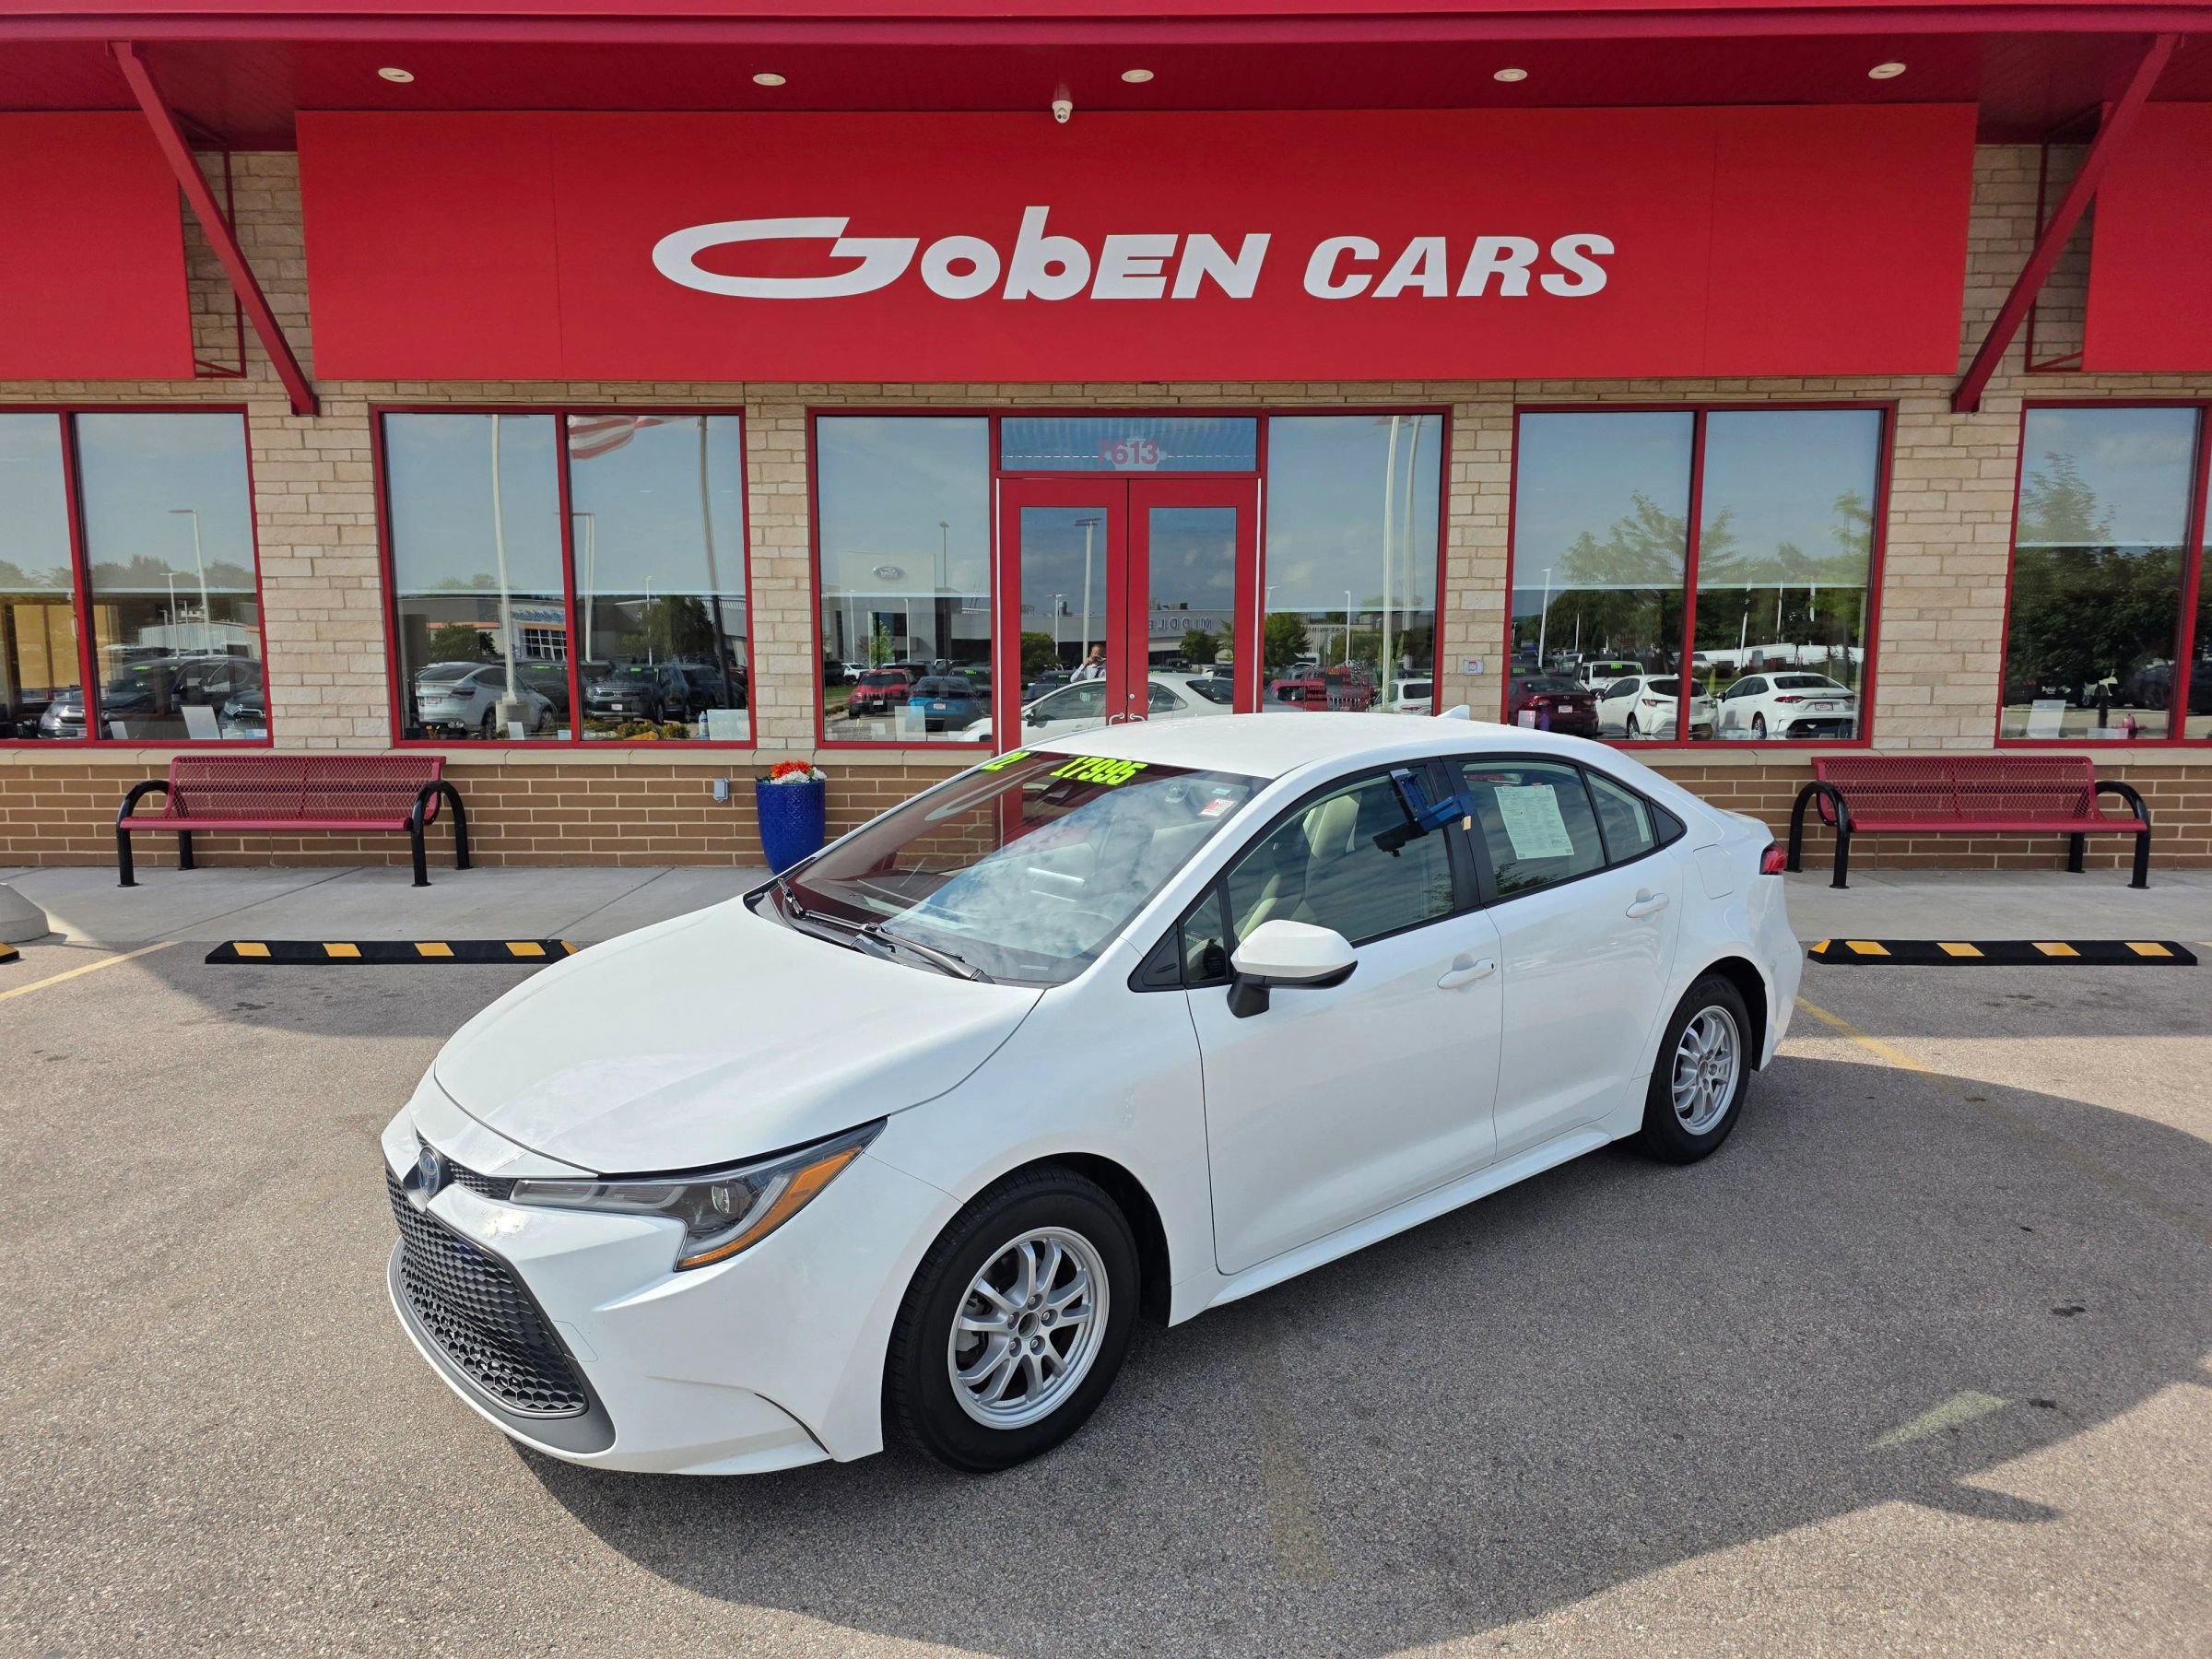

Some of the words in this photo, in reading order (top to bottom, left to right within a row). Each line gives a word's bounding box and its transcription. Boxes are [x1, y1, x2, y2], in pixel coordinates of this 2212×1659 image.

[1303, 233, 1615, 300] CARS
[1095, 439, 1159, 465] 7613
[1050, 756, 1148, 785] 17995
